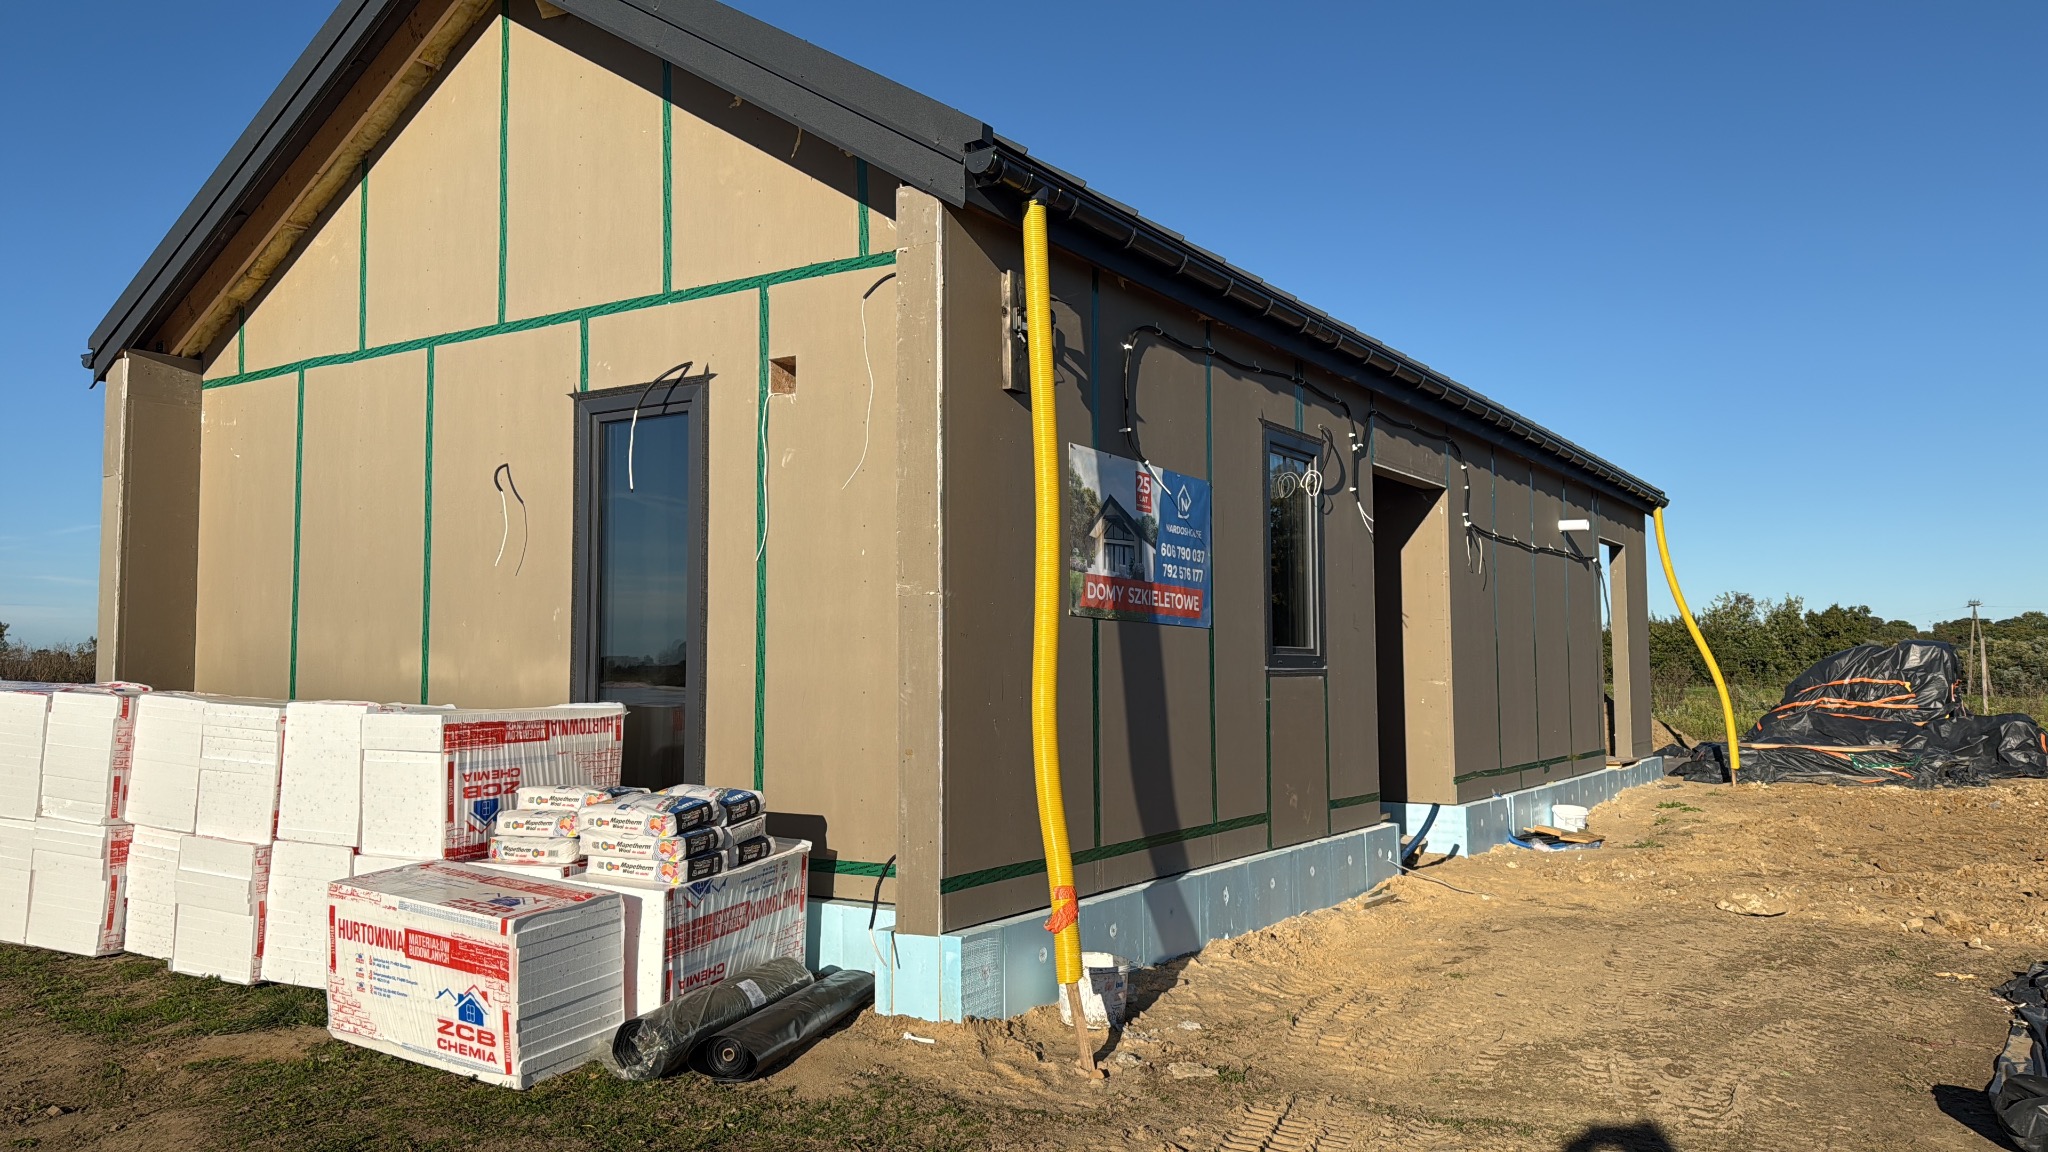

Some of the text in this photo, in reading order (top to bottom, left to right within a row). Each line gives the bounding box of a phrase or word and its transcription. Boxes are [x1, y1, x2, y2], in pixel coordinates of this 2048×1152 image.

[1137, 474, 1150, 494] 25
[1139, 494, 1148, 503] LAT
[1161, 543, 1205, 564] 606 790 037
[1162, 563, 1204, 583] 792 576 177
[1087, 581, 1200, 612] DOMY SZKIELETOWE
[551, 715, 613, 736] HURTOWNIA
[462, 767, 521, 783] CHEMIA
[463, 780, 520, 799] ZCB
[610, 817, 642, 825] Mapetherm
[616, 841, 652, 849] Mapetherm
[620, 862, 654, 871] Mapetherm
[337, 917, 404, 952] HURTOWNIA
[408, 932, 450, 954] MATERIAŁÓW
[678, 962, 725, 988] CHEMIA
[437, 1018, 497, 1048] ZCB
[437, 1037, 498, 1064] CHEMIA
